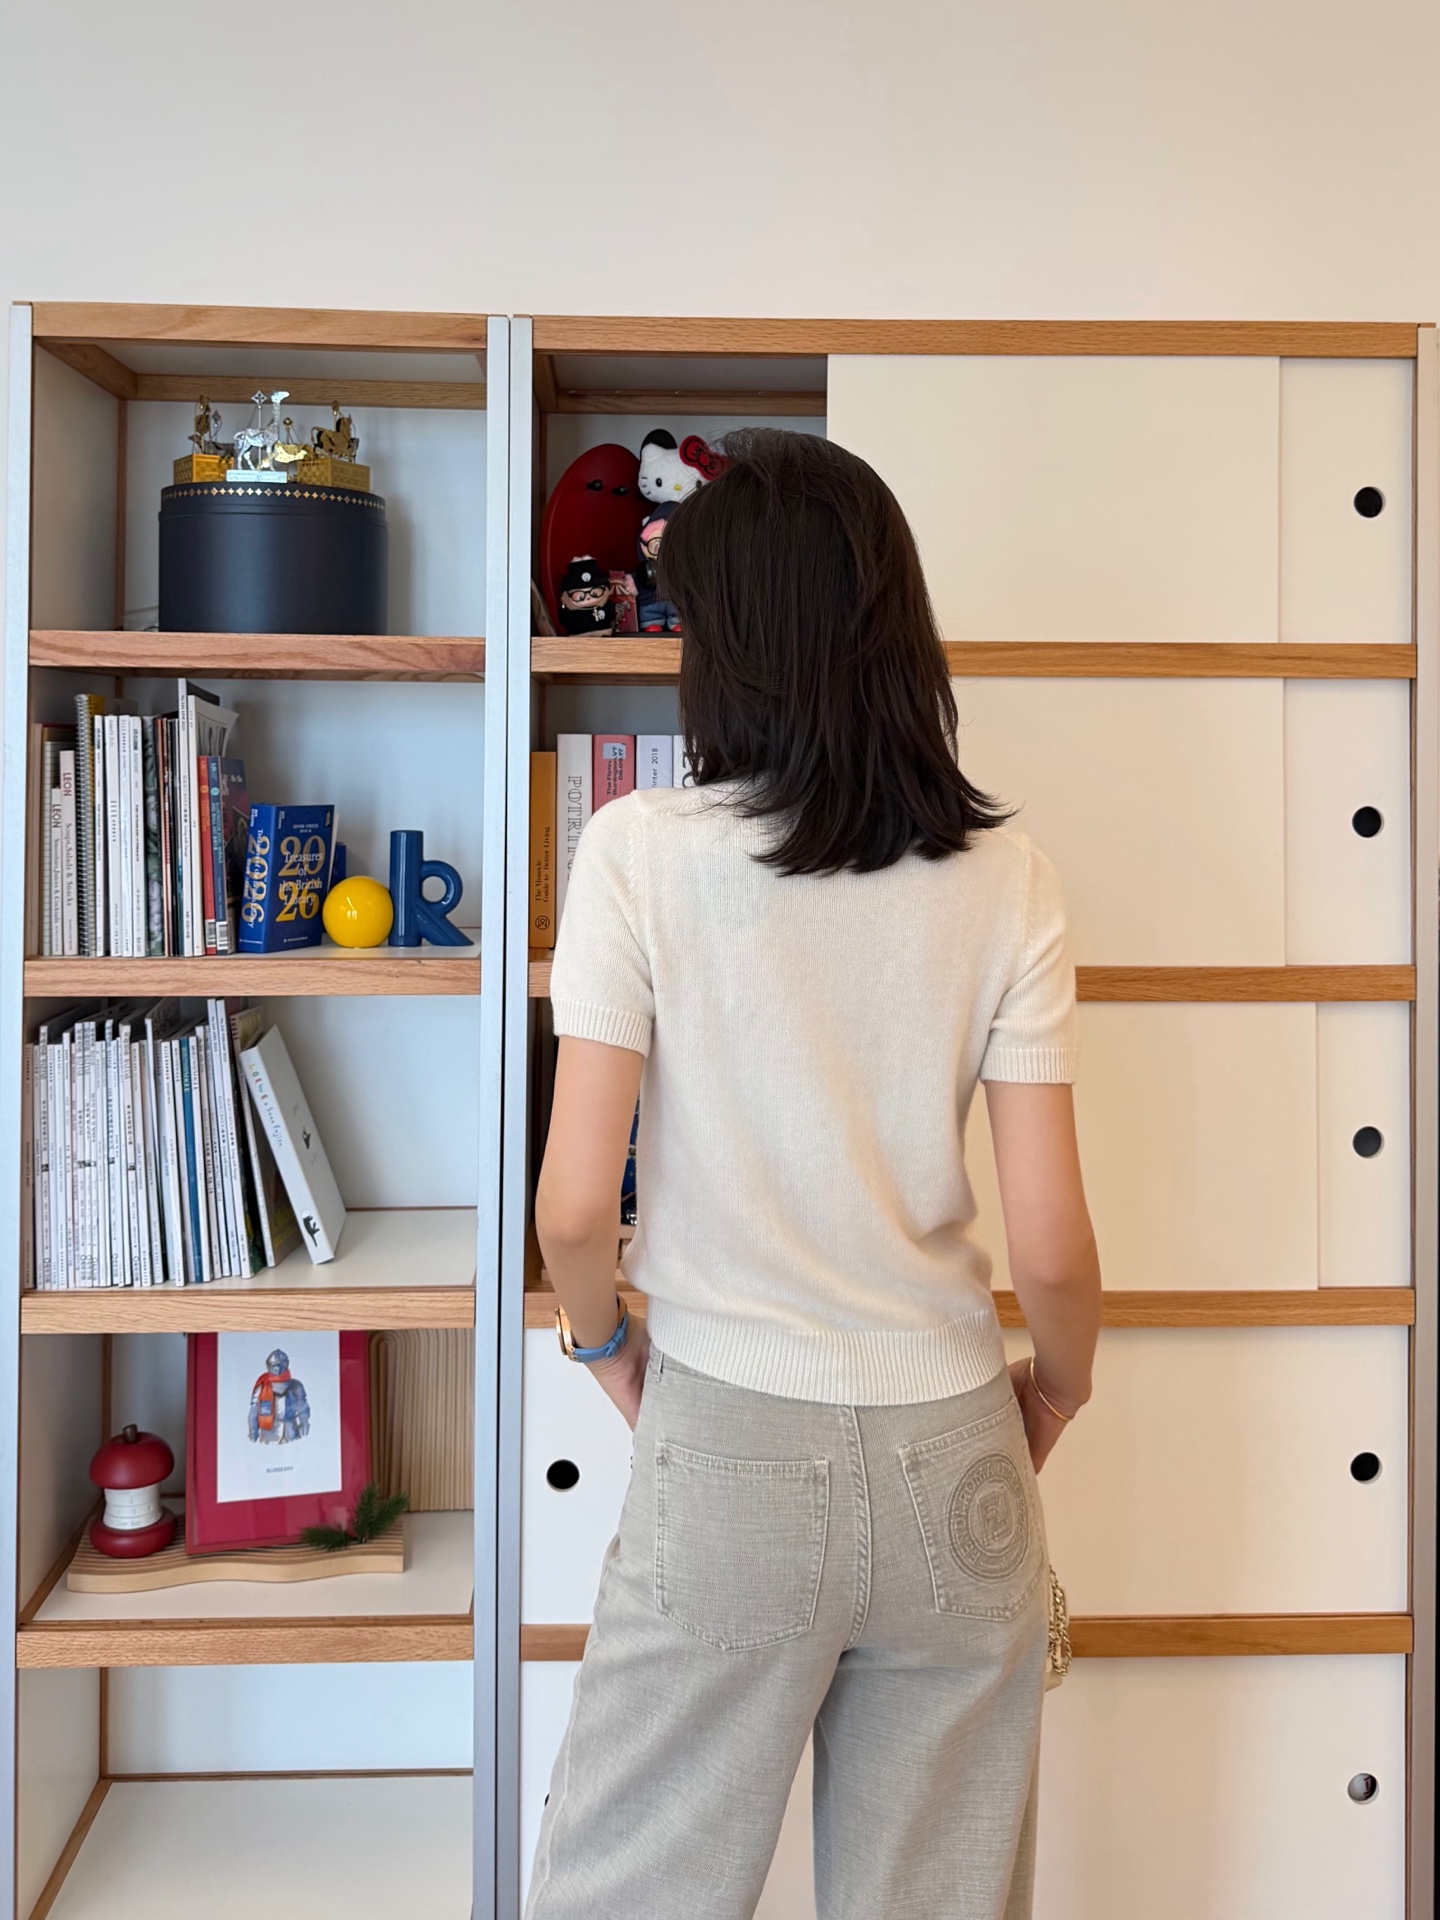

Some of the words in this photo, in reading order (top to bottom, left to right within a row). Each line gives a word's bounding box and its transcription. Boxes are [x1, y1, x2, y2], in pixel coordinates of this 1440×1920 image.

[63, 772, 72, 796] LEON
[52, 804, 61, 828] LEON
[278, 835, 326, 877] 20
[284, 851, 323, 863] Treasures
[242, 834, 270, 924] 2026
[298, 864, 308, 876] of
[66, 882, 74, 906] Snacks
[294, 877, 323, 891] British
[275, 880, 320, 923] 26
